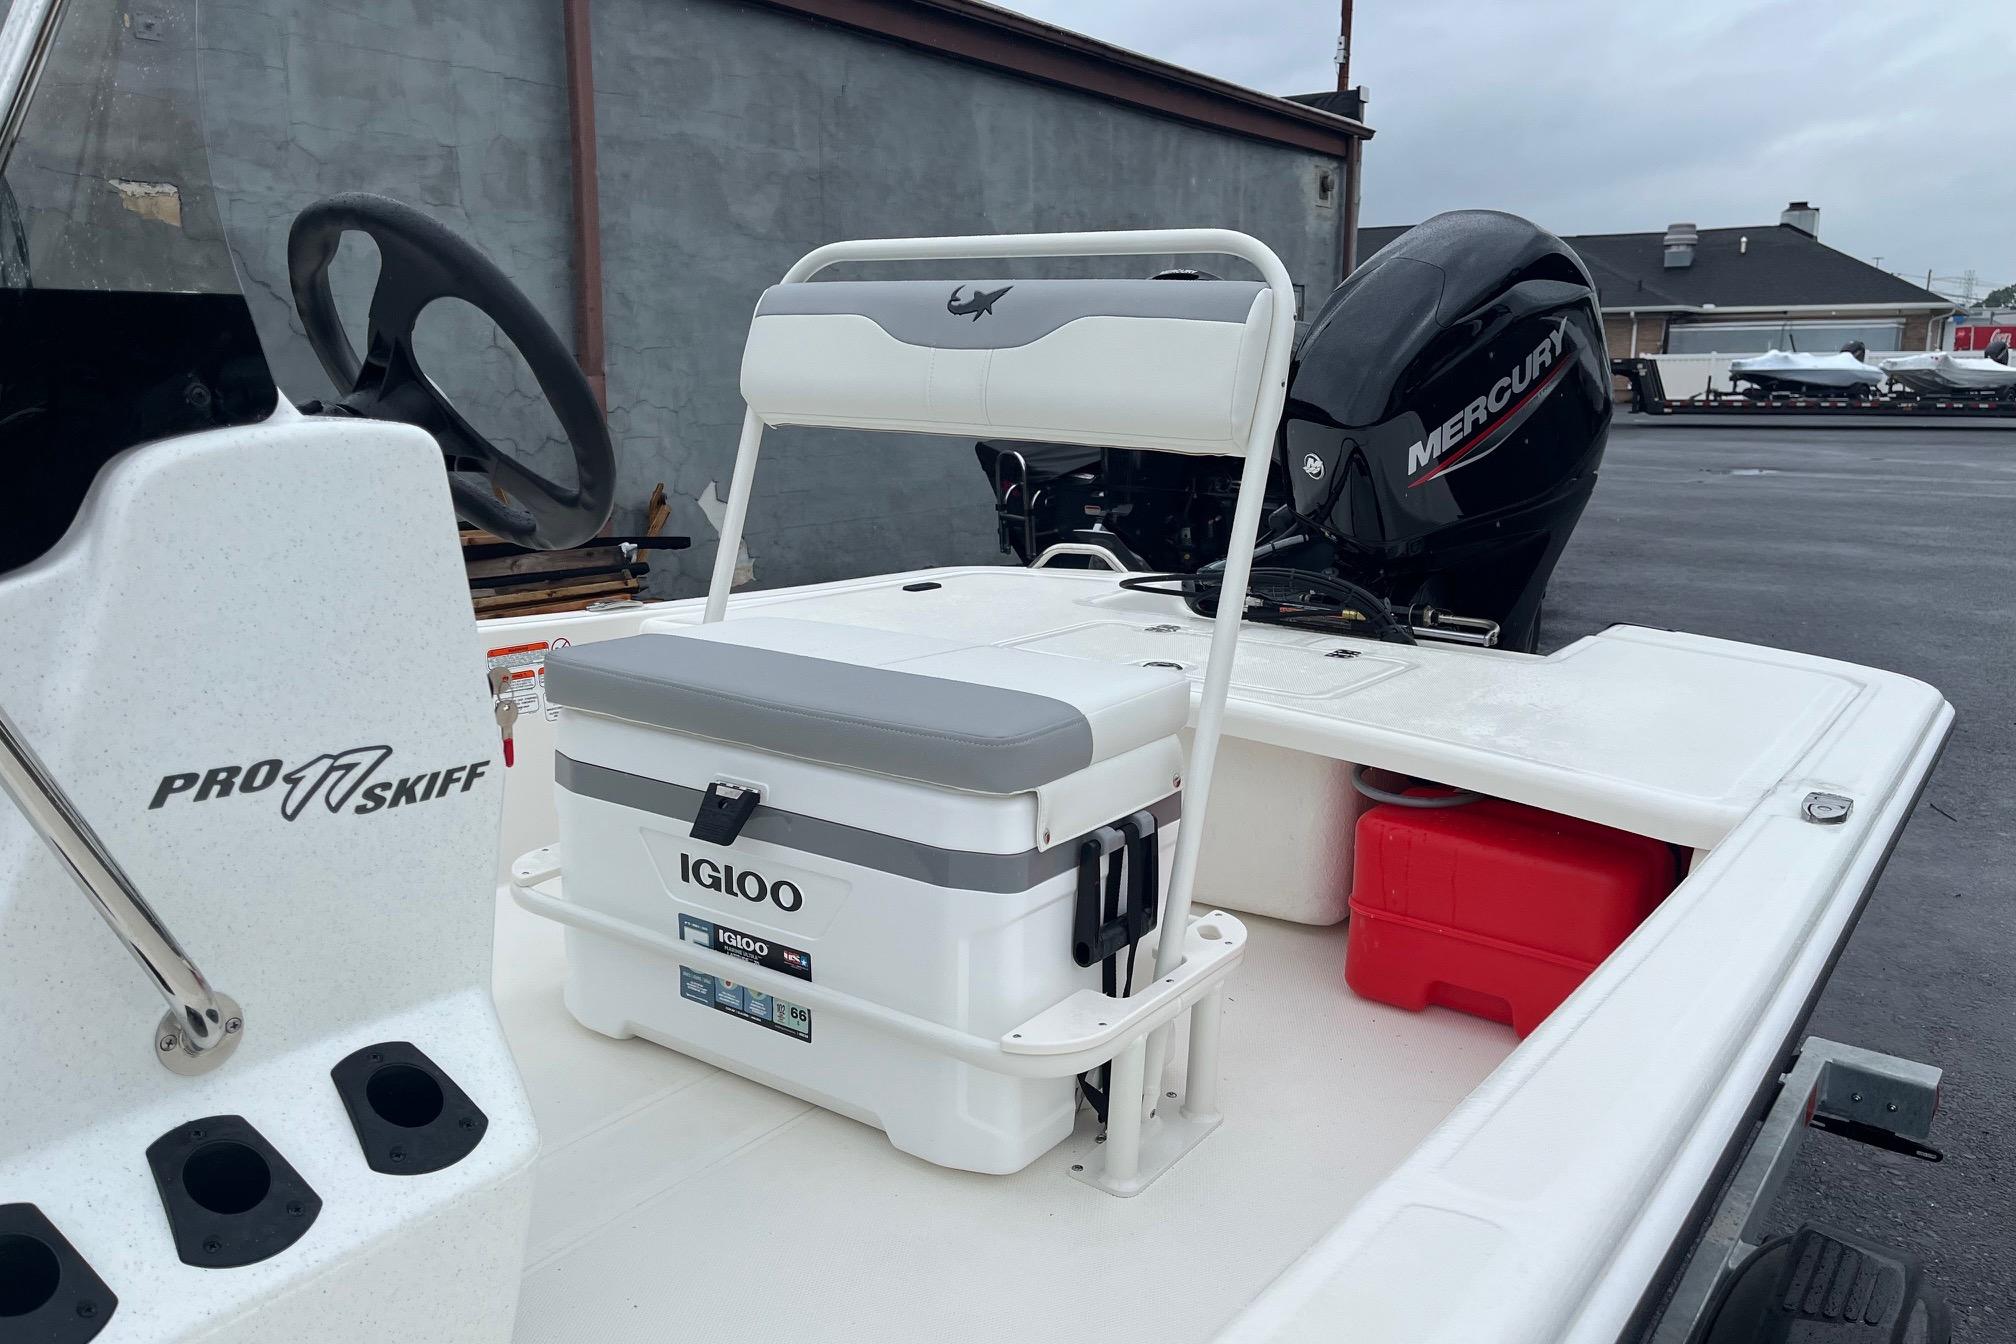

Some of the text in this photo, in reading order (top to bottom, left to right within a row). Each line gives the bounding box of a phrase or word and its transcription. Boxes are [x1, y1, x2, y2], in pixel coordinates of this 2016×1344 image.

[1407, 316, 1568, 476] MERCURY
[148, 758, 284, 810] PRO
[354, 760, 491, 815] SKIFF
[680, 852, 803, 912] IGLOO
[718, 929, 768, 956] IGLOO
[791, 1006, 807, 1022] 66
